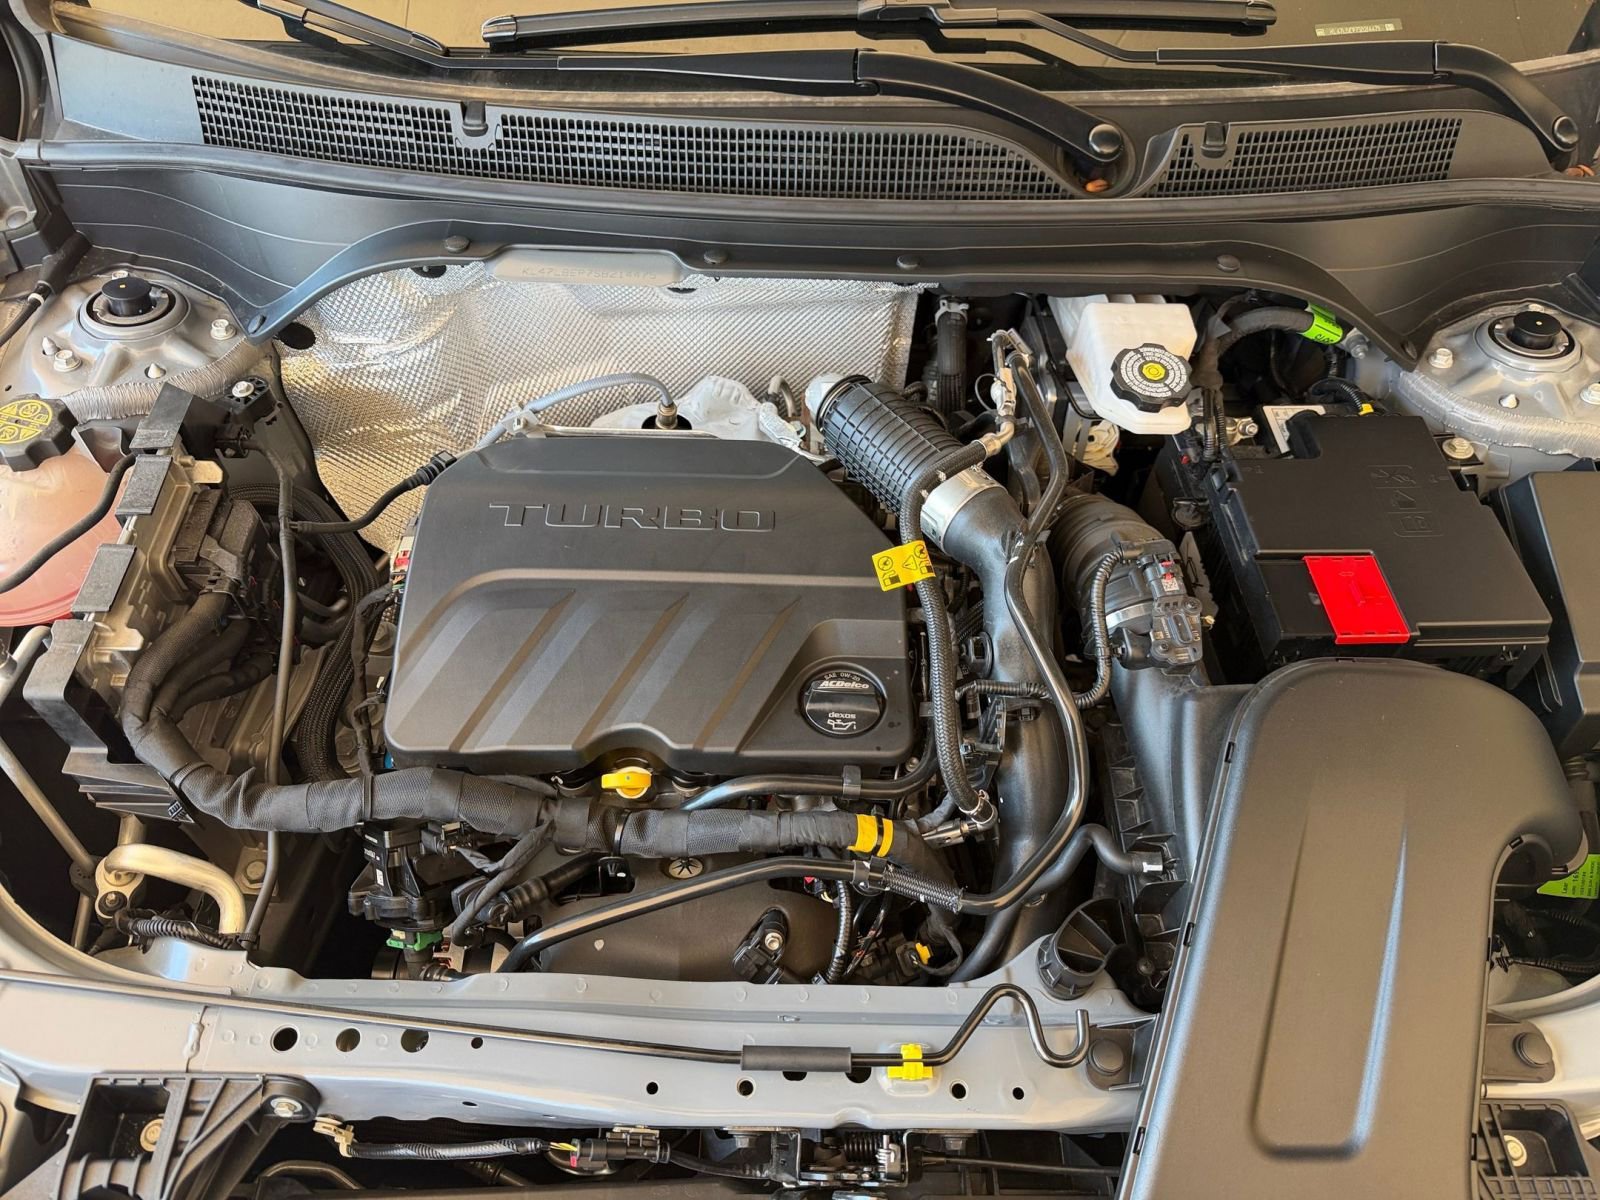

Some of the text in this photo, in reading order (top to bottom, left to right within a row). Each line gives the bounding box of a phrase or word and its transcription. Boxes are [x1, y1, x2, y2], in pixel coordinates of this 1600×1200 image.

[489, 503, 776, 532] TURBO
[823, 672, 837, 680] SAE
[819, 681, 869, 689] ACDelco
[828, 711, 857, 719] dexos
